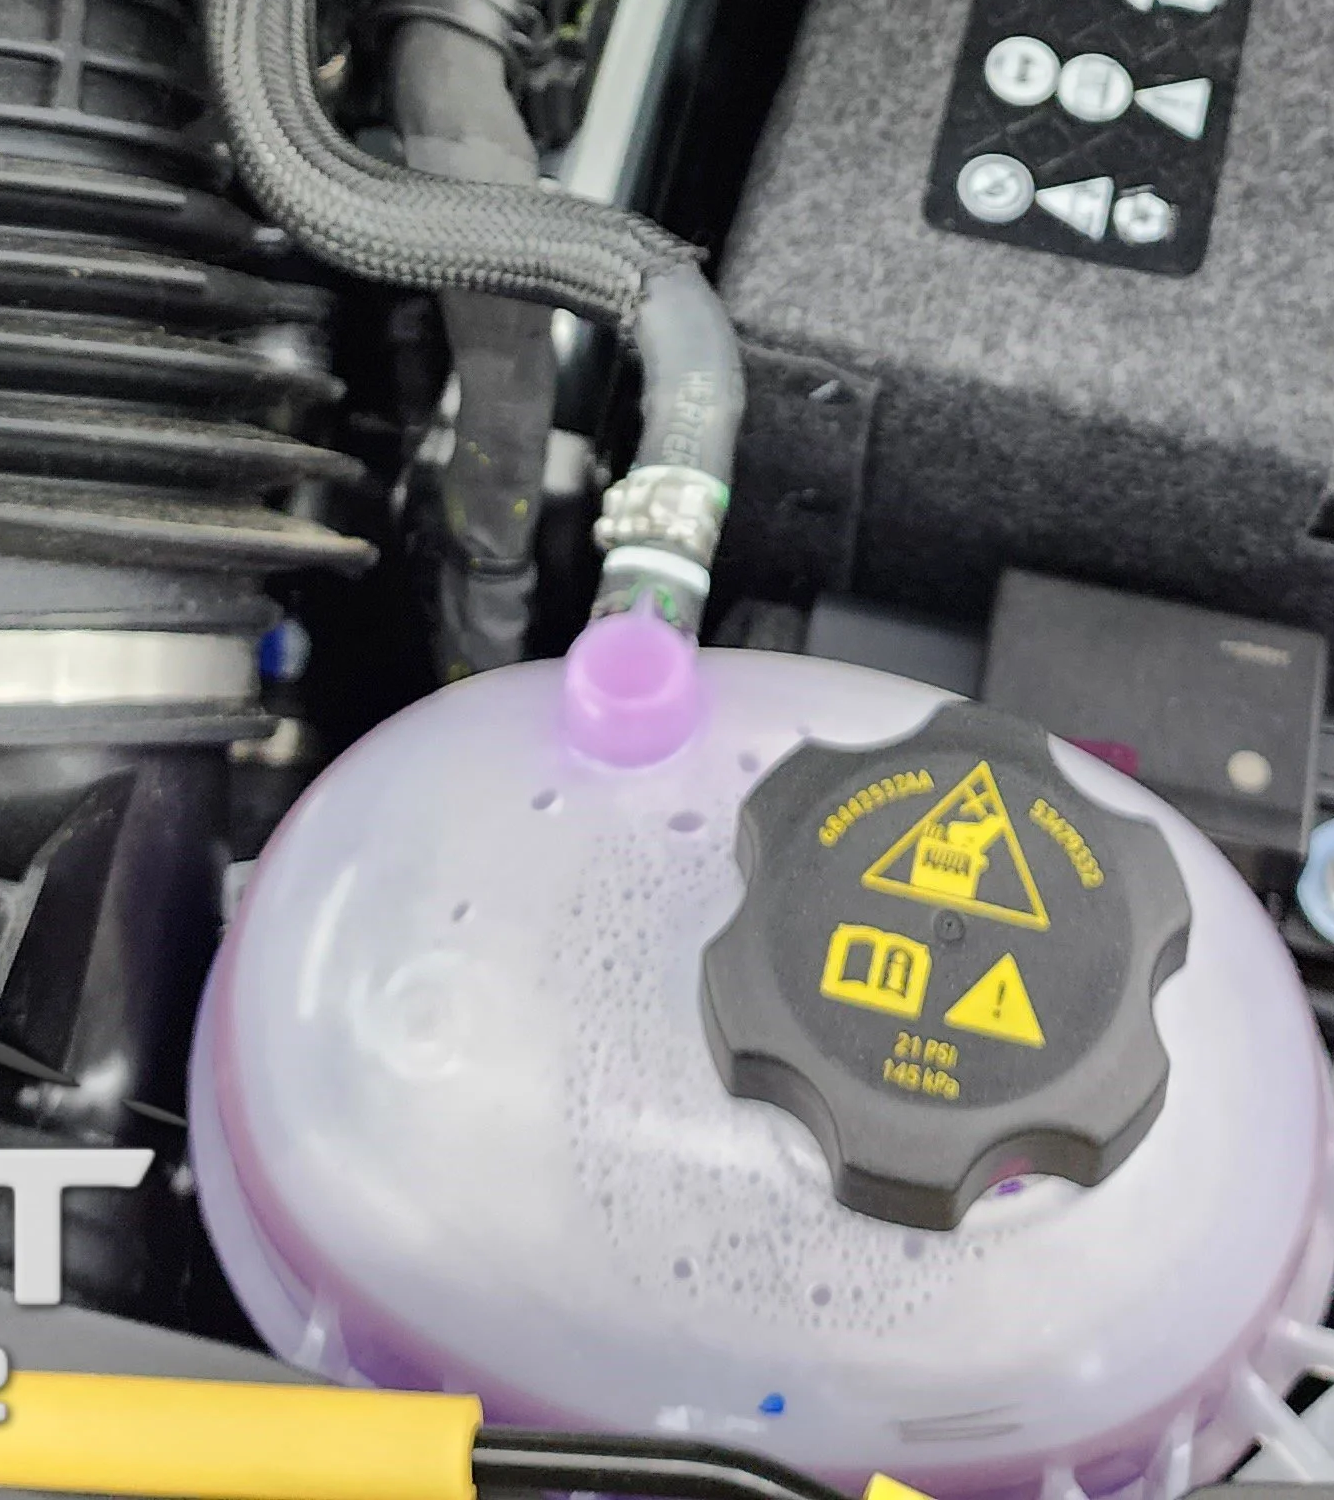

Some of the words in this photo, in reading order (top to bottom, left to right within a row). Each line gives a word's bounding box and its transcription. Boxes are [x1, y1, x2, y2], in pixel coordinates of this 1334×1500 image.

[894, 1030, 923, 1060] 21
[924, 1037, 959, 1071] PSI
[883, 1056, 923, 1094] 145
[922, 1065, 961, 1101] kPa
